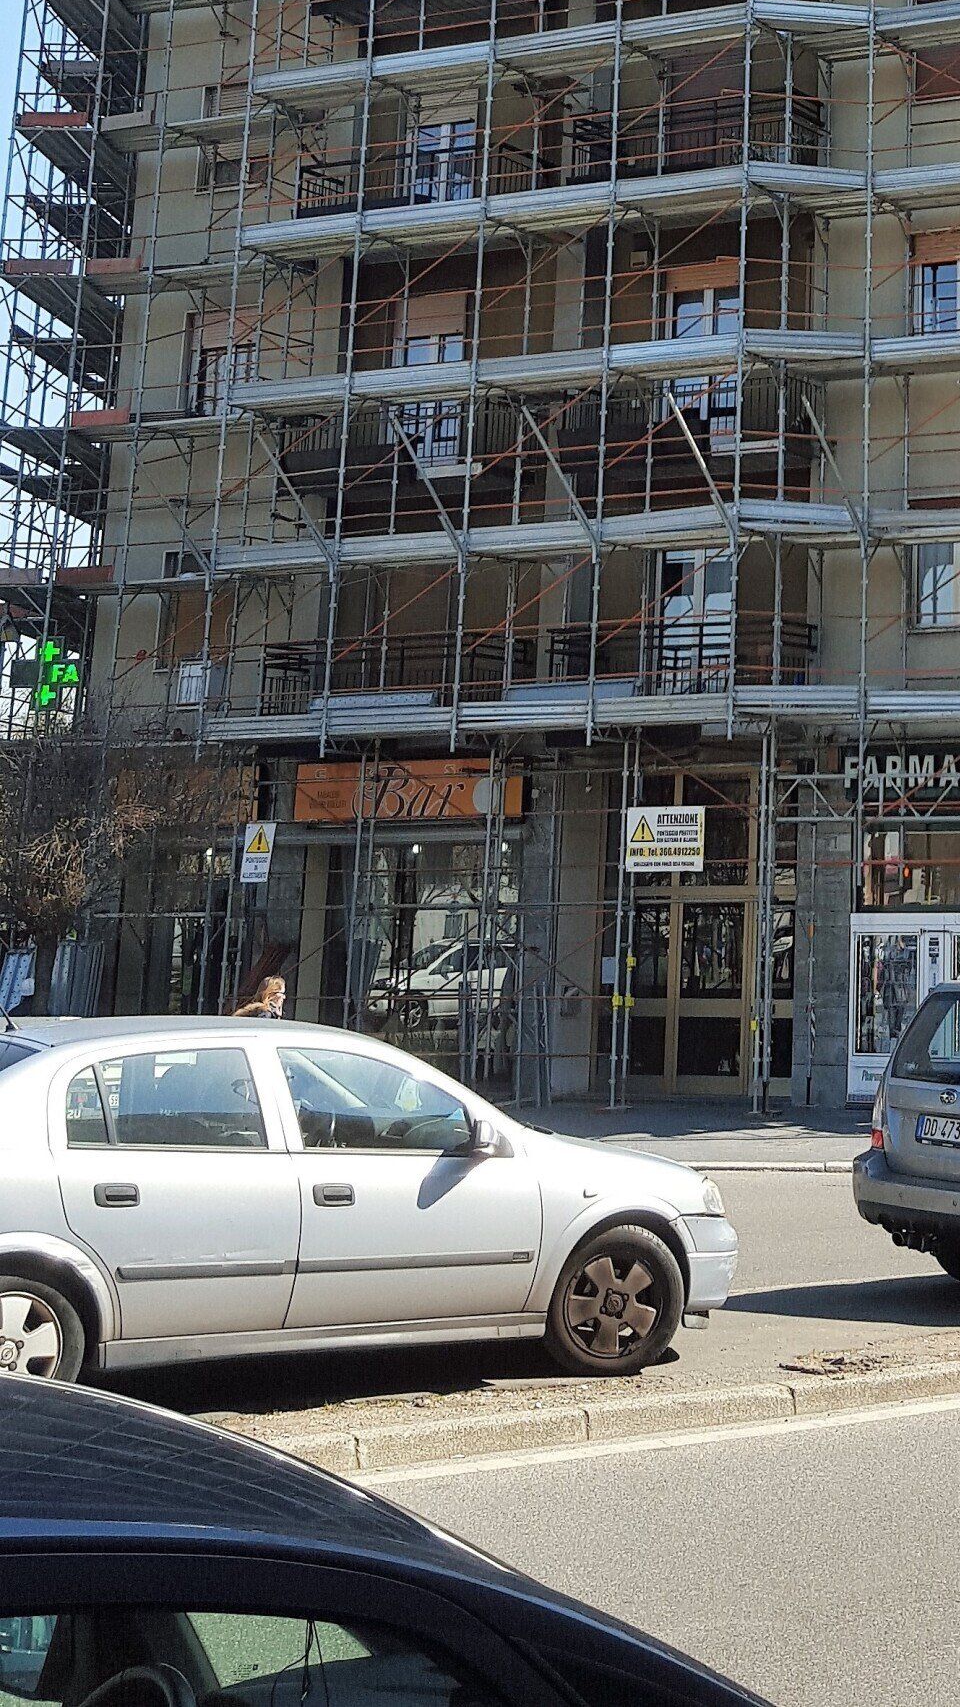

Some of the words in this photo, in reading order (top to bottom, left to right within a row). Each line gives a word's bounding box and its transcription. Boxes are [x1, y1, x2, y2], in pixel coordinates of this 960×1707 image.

[51, 664, 79, 682] FA
[352, 764, 466, 819] Bar
[657, 814, 698, 824] ATTENZIONE
[923, 1118, 938, 1136] DD
